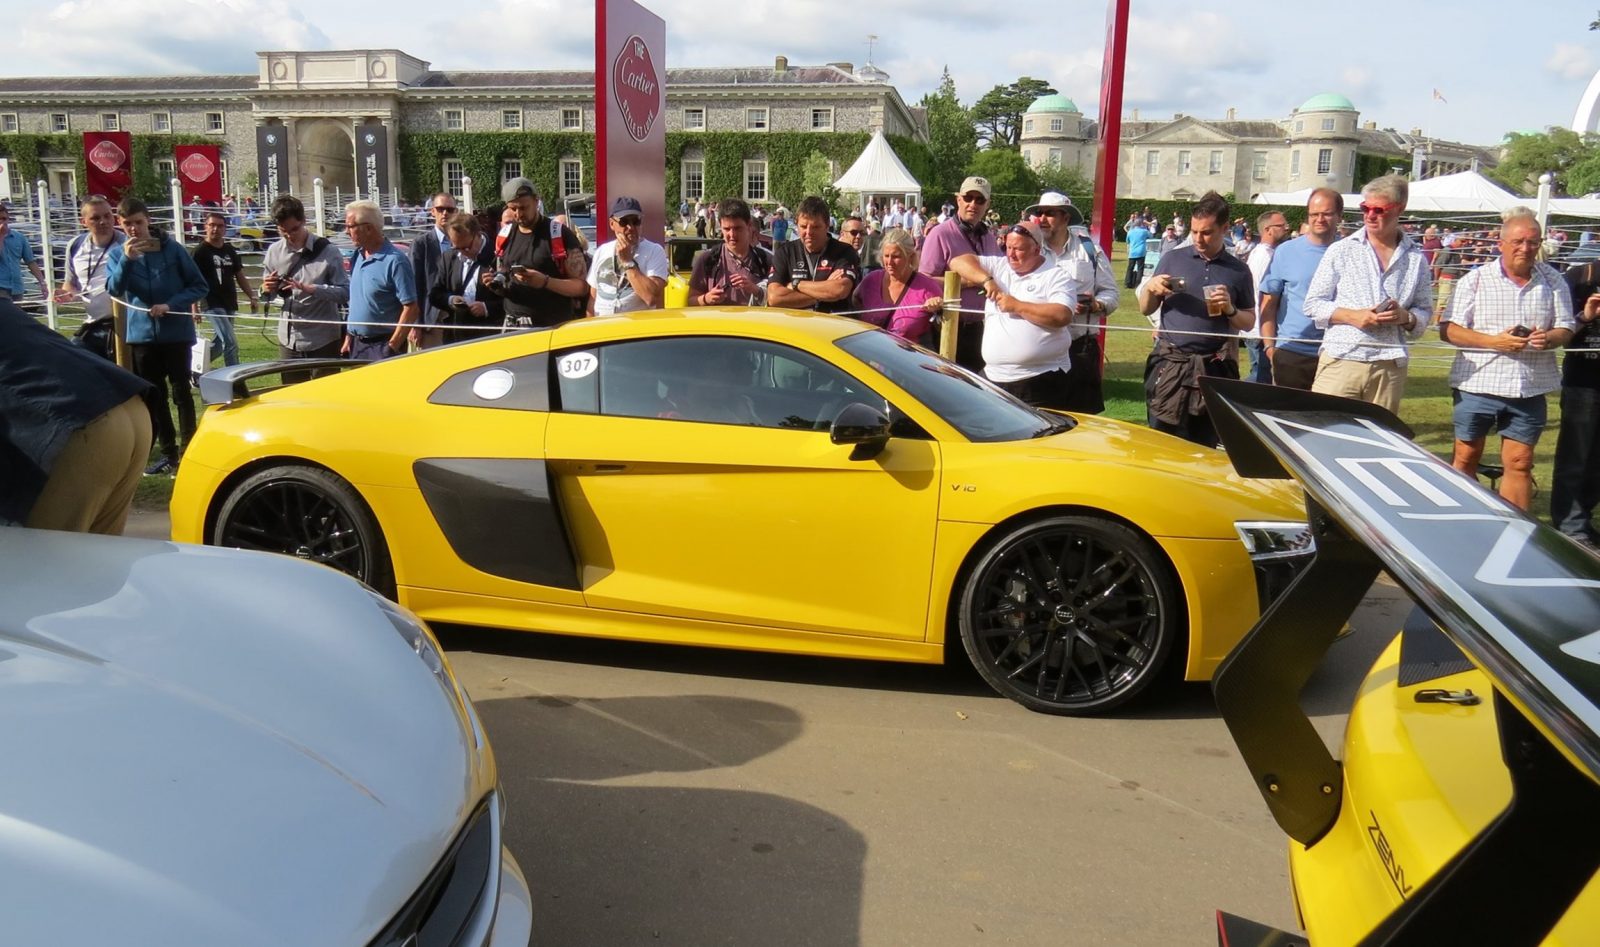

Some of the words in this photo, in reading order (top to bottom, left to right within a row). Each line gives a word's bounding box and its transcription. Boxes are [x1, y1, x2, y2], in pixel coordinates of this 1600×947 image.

[633, 40, 645, 60] THE
[621, 56, 655, 96] Cartier
[623, 99, 636, 134] STYLE
[637, 126, 643, 138] ET
[564, 358, 592, 374] 307
[951, 484, 977, 493] V10
